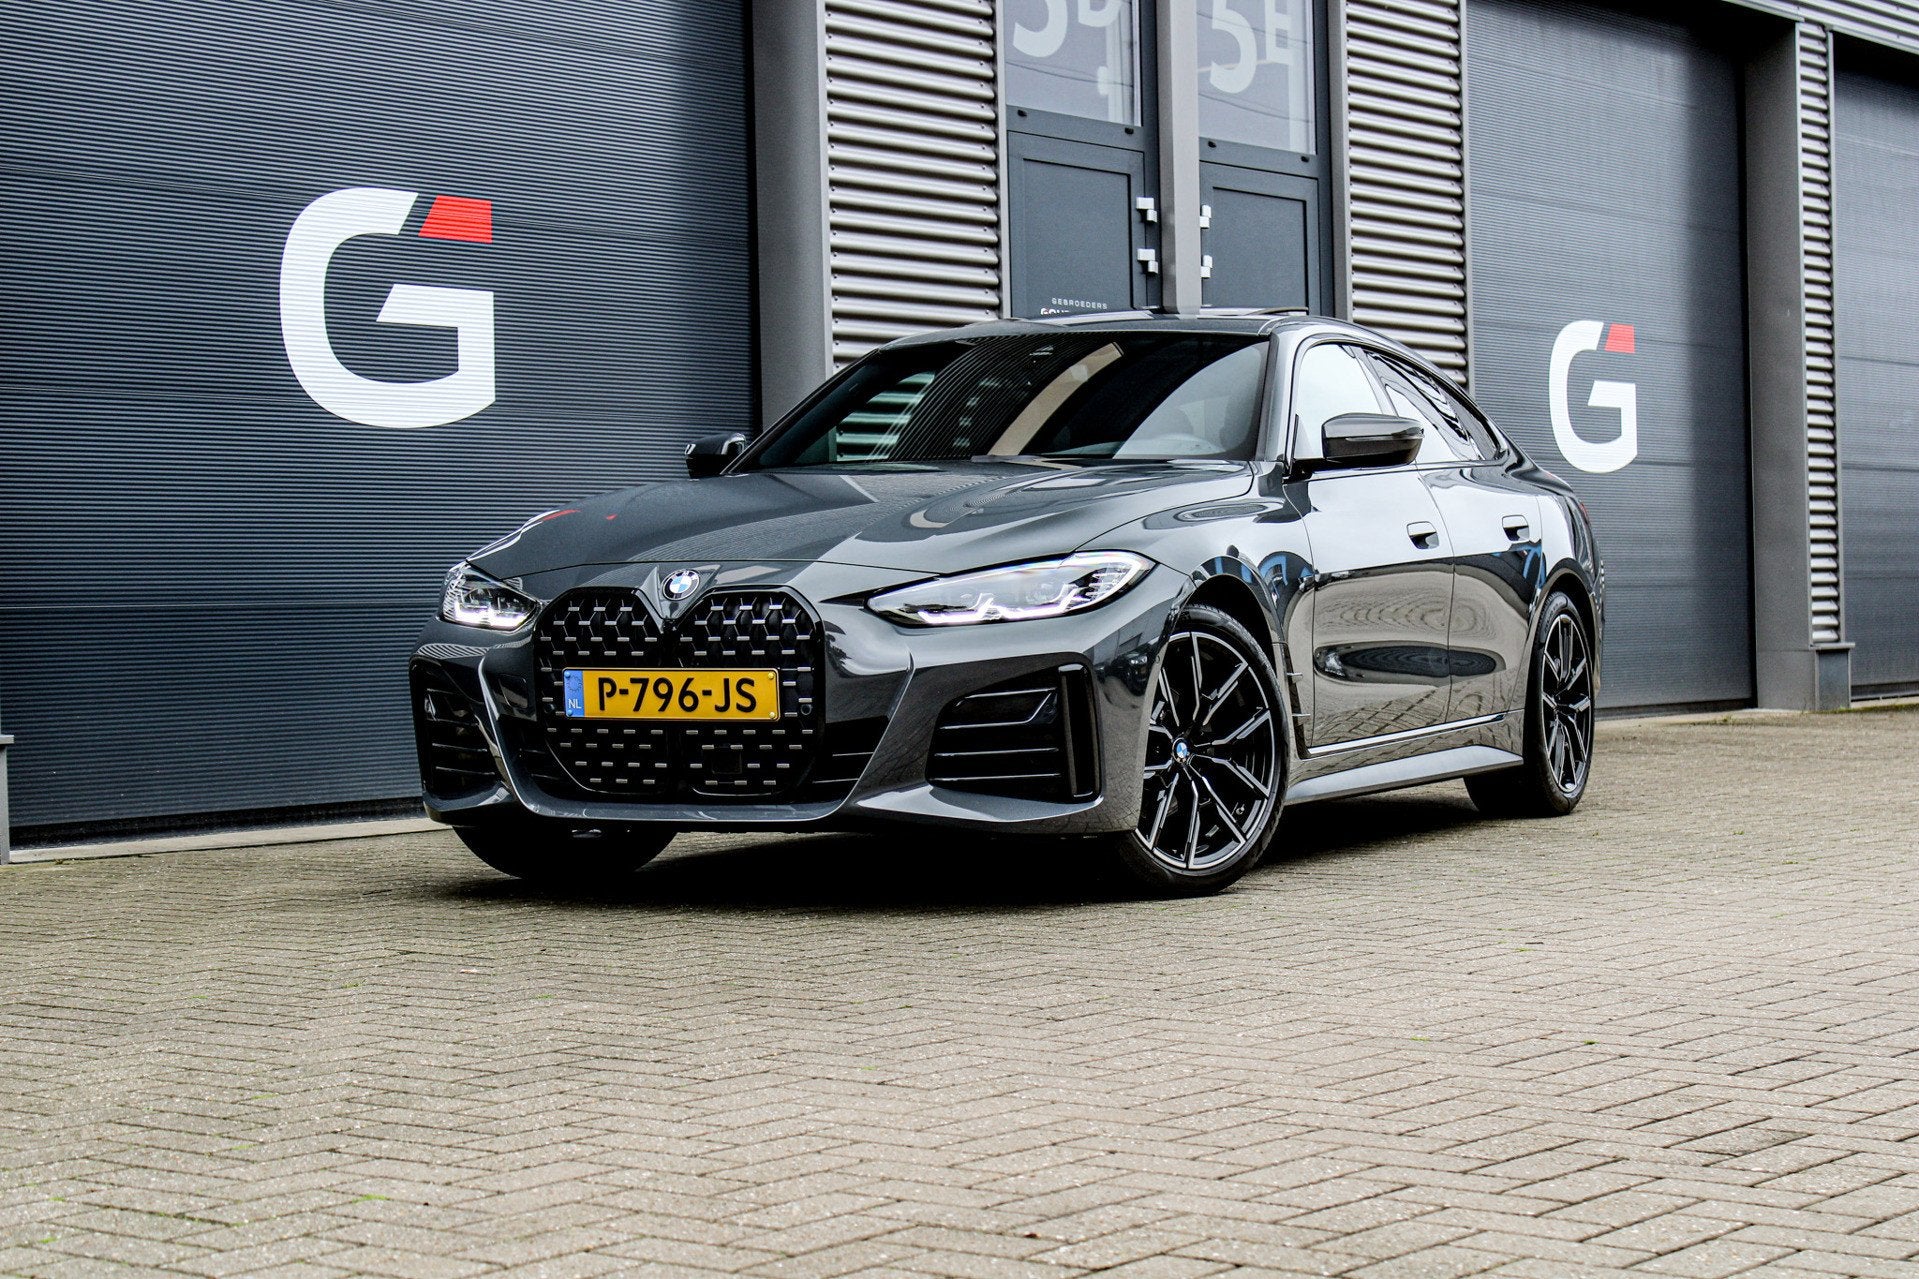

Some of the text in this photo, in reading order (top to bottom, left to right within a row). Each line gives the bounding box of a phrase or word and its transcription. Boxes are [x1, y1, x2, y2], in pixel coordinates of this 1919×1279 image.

[279, 187, 496, 429] G
[1051, 297, 1108, 310] GEBROEDERS
[1549, 320, 1638, 473] G
[568, 698, 582, 709] NL
[598, 677, 757, 713] P-796-JS
